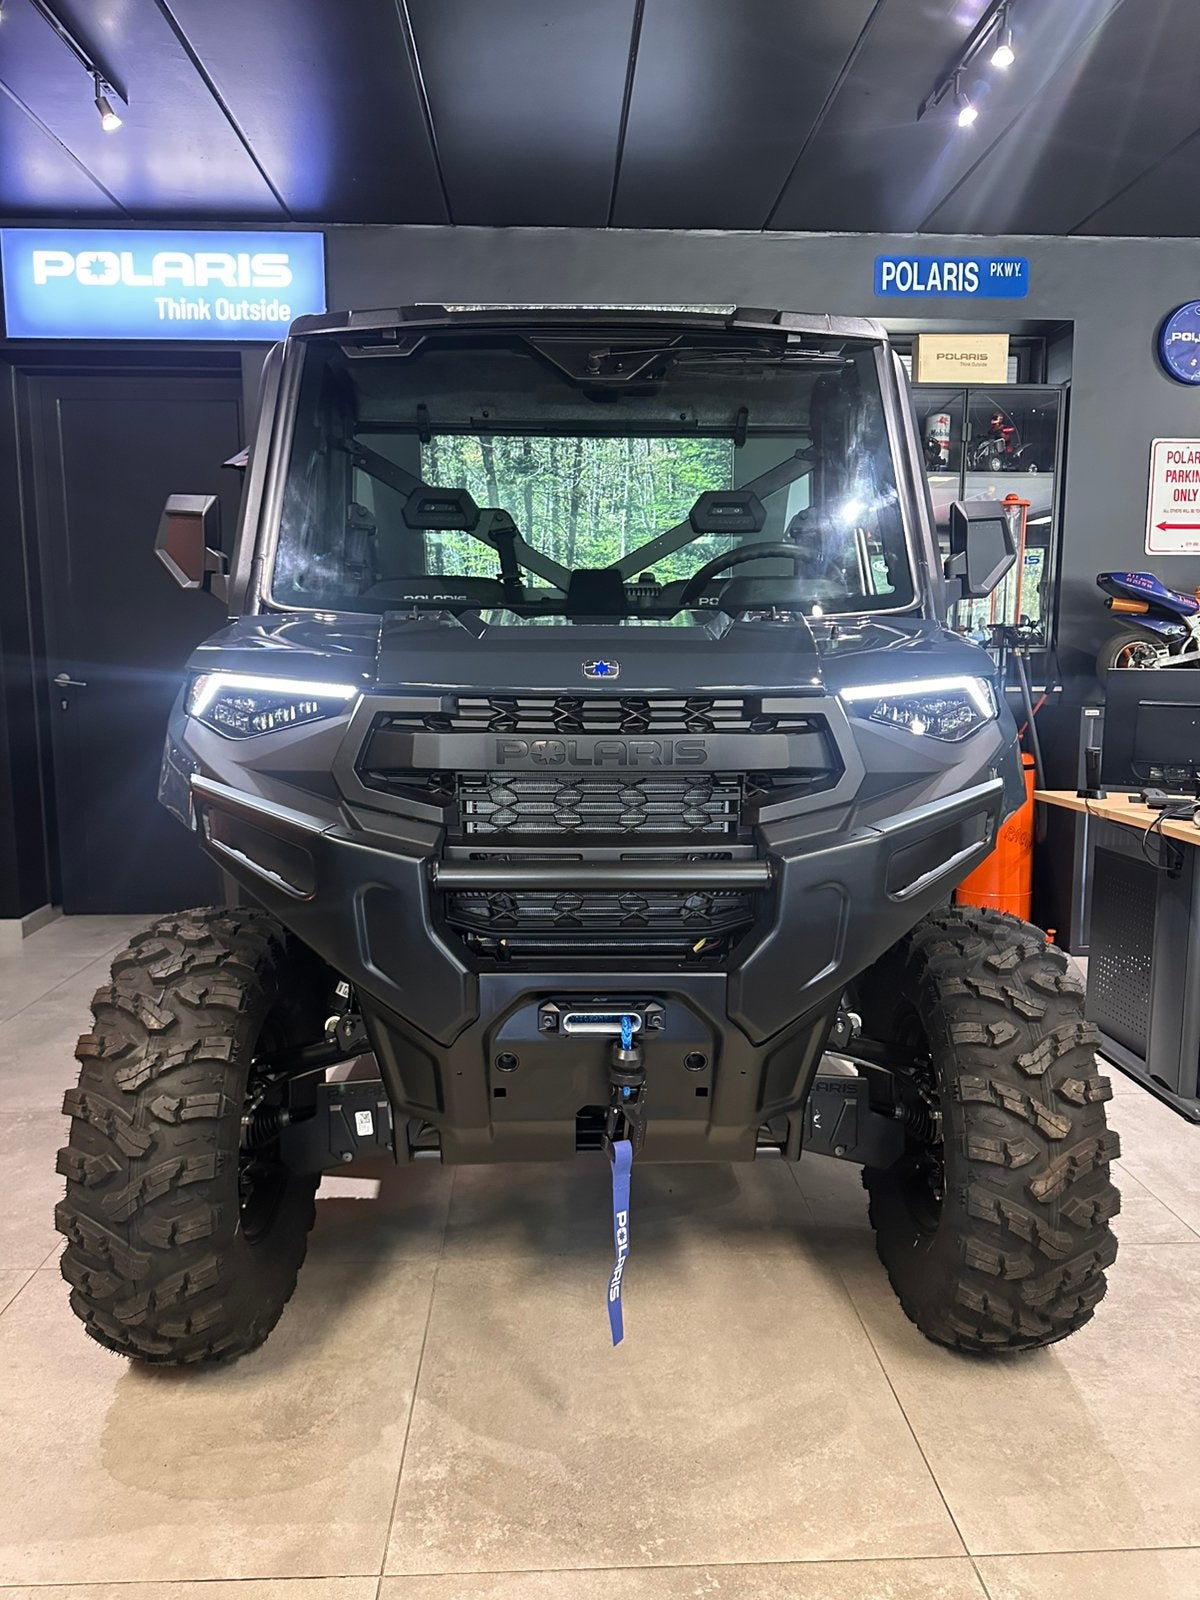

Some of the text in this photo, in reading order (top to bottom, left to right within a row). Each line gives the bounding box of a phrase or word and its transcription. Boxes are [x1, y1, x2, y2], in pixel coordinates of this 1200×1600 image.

[32, 250, 293, 288] POLARIS
[881, 261, 1022, 293] POLARIS PKWY.
[155, 297, 291, 322] Think Outside
[936, 353, 988, 361] POLARIS
[1173, 488, 1199, 502] ONLY
[495, 738, 708, 766] POLARIS
[609, 1210, 627, 1302] POLARIS
